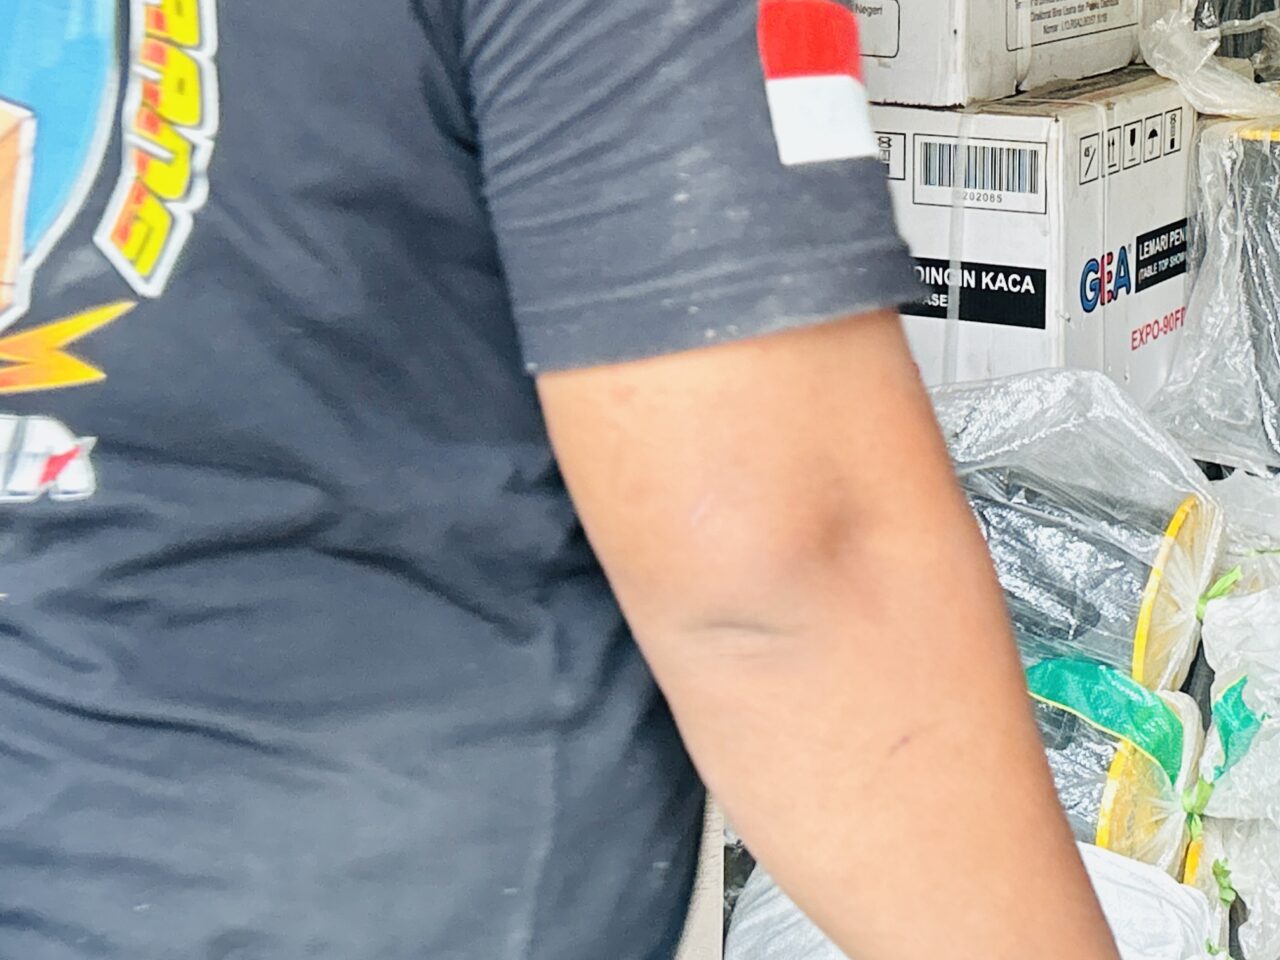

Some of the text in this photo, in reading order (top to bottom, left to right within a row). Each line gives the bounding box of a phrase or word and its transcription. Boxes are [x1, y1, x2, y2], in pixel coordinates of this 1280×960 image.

[962, 191, 1003, 203] 202085
[1138, 228, 1186, 261] LEMARI PEN
[1158, 259, 1169, 275] TOP
[1169, 251, 1186, 268] SHOW
[914, 266, 1036, 294] DINGIN KACA
[1079, 245, 1132, 314] GEA
